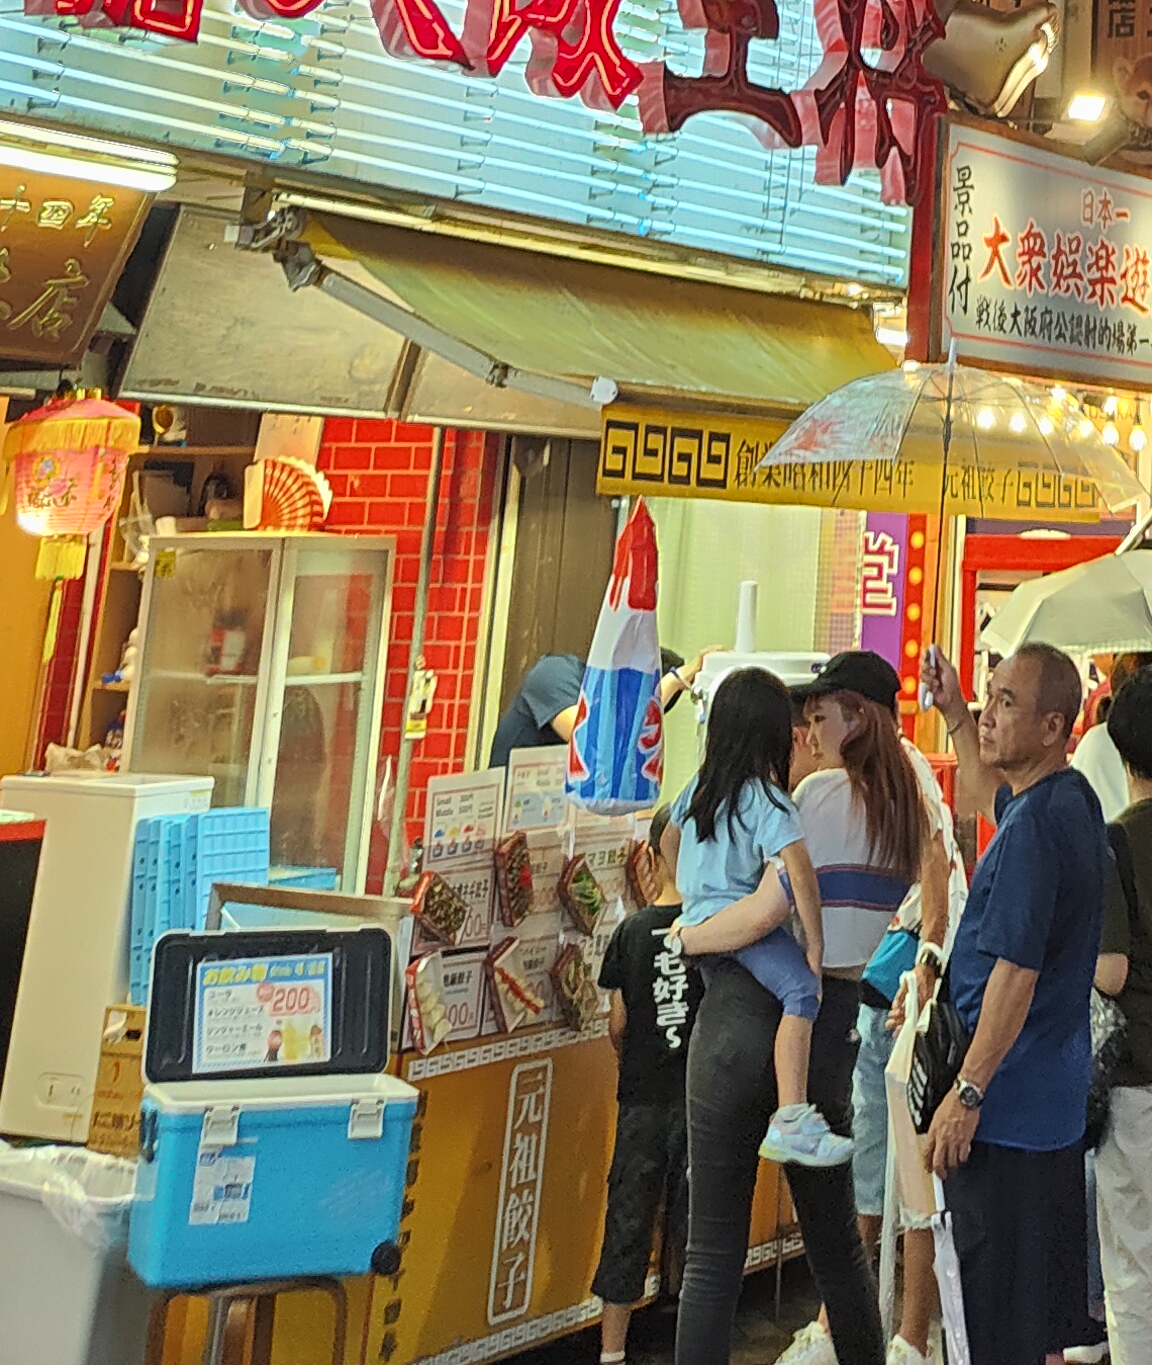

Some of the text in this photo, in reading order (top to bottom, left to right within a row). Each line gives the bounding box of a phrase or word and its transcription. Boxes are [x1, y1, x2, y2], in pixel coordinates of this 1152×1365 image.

[949, 165, 976, 316] 景品付
[1082, 186, 1131, 232] 日本一
[498, 1072, 544, 1309] 元祖餃子
